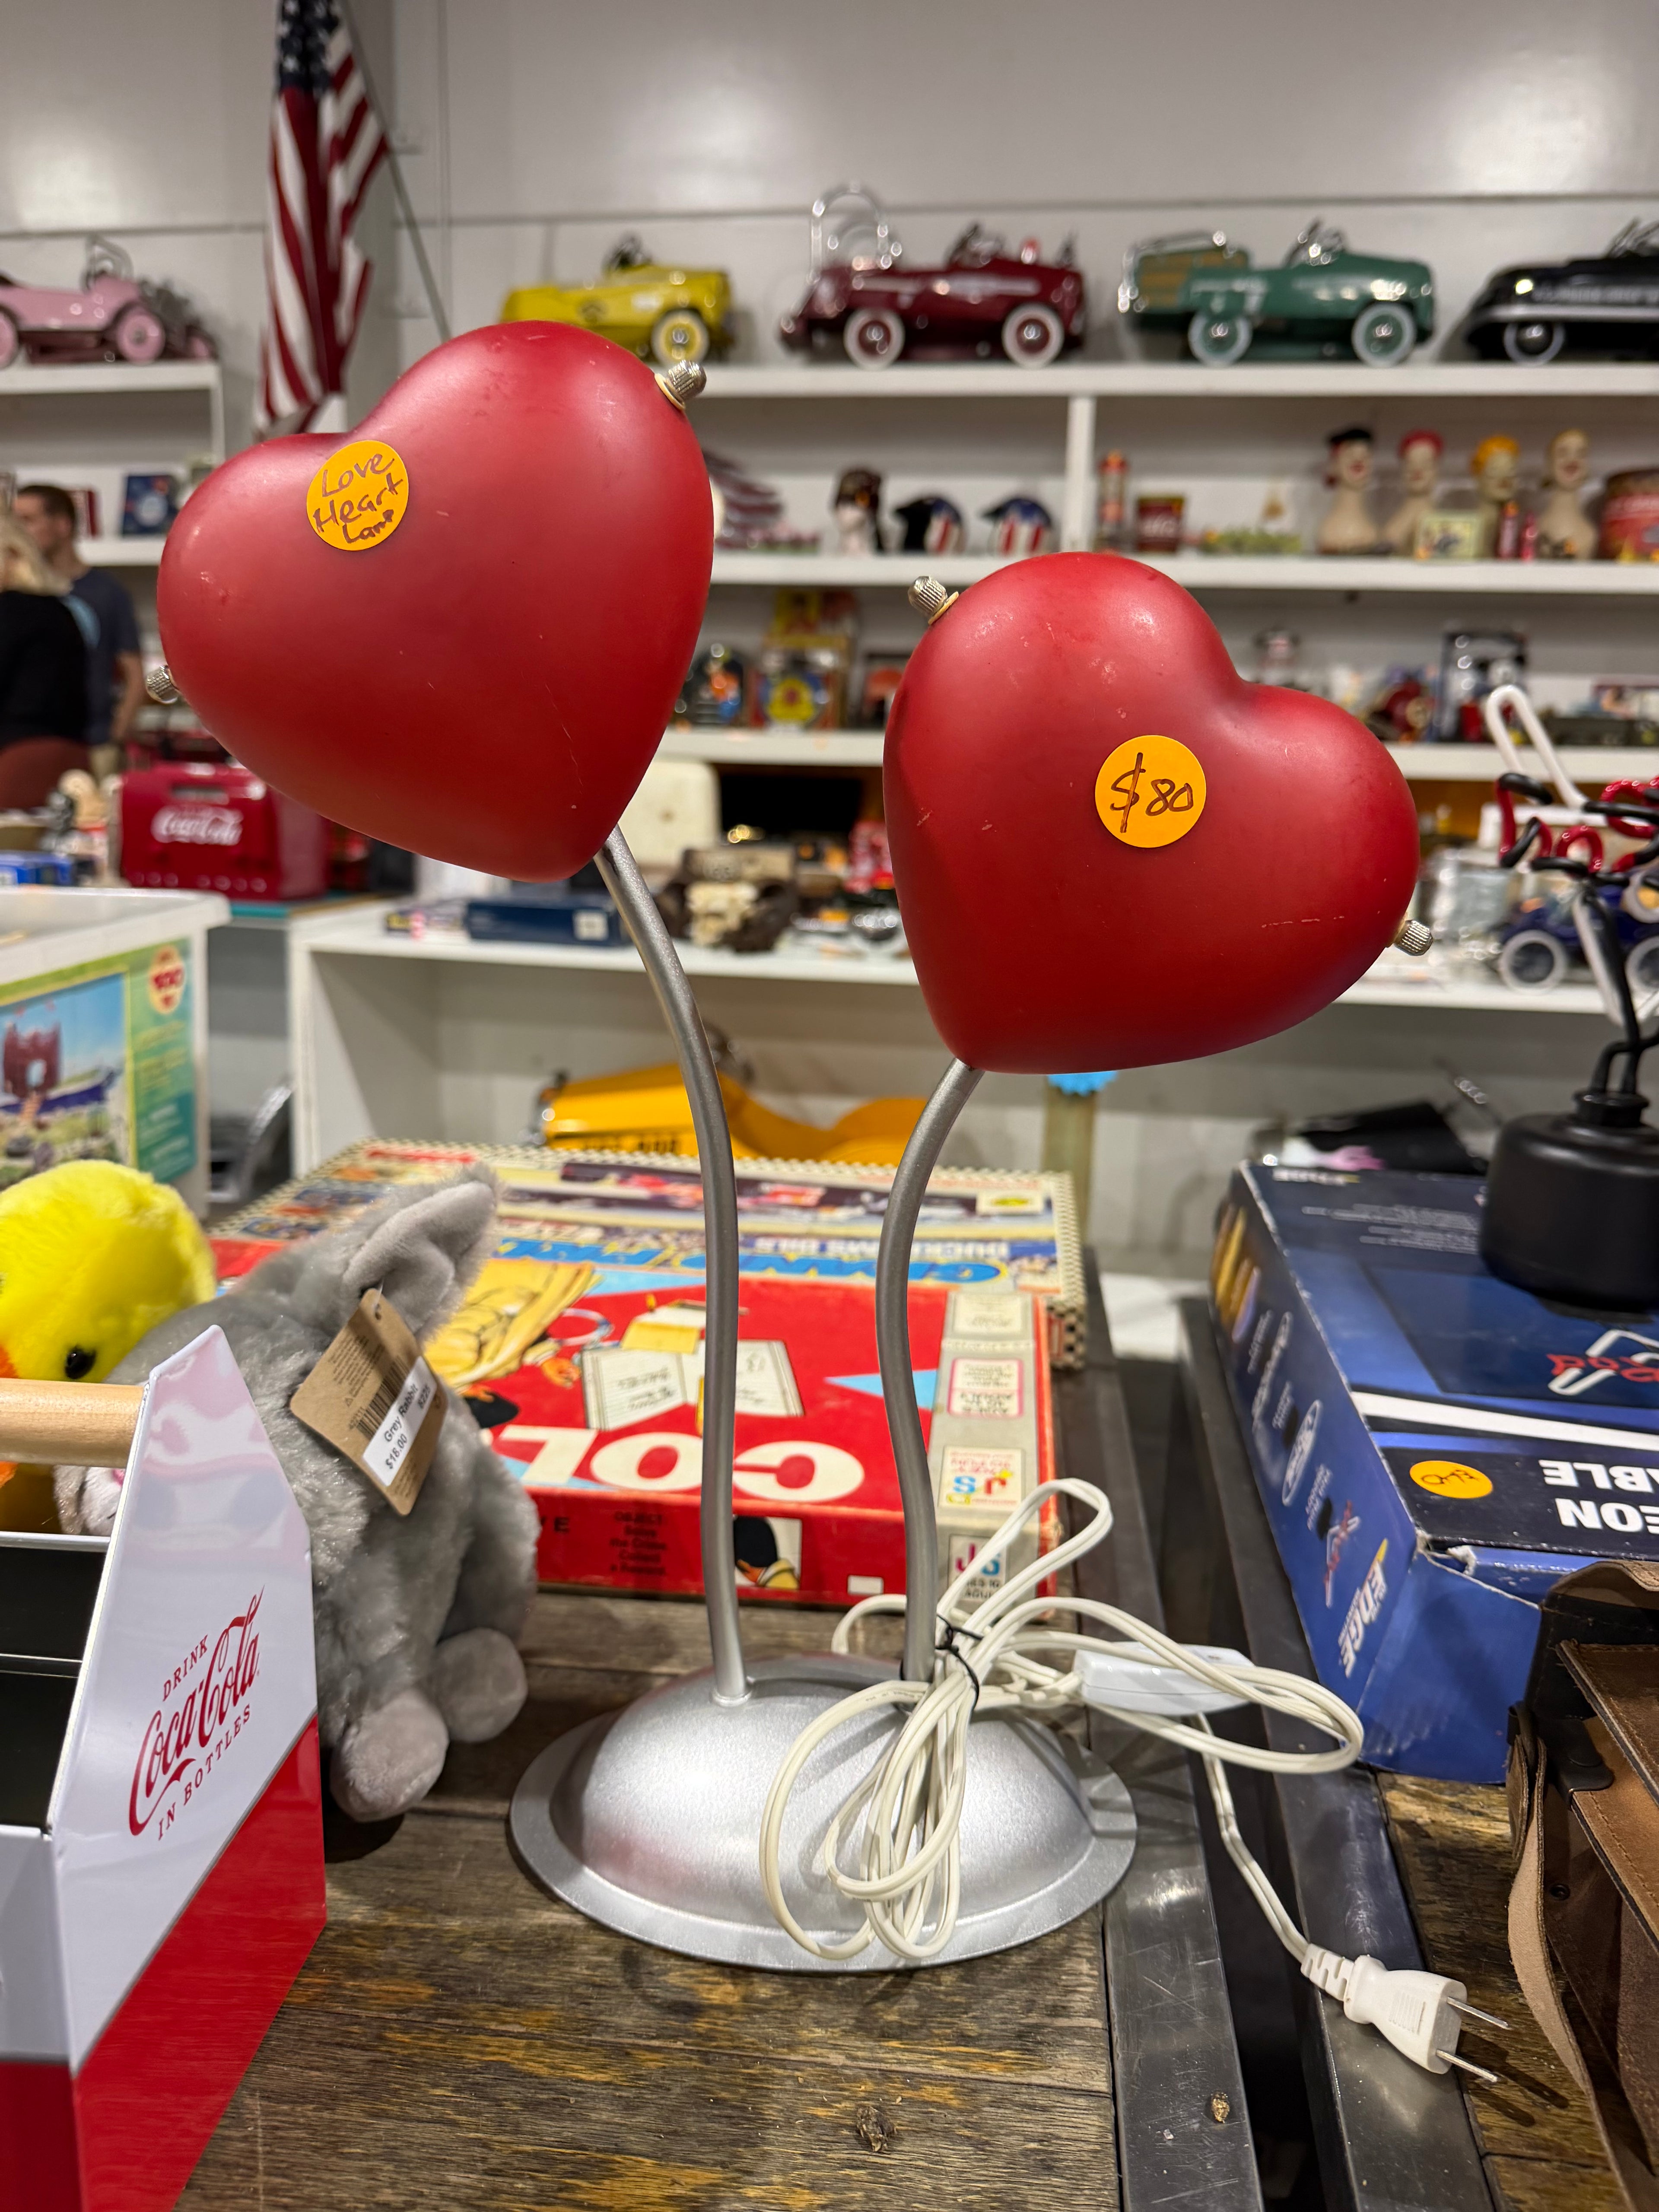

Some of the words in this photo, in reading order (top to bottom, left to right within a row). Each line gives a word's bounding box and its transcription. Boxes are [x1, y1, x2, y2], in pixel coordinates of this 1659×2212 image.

[313, 473, 403, 532] Heart
[322, 454, 394, 497] Love
[1110, 752, 1194, 833] $80
[384, 1417, 402, 1442] Grey
[398, 1384, 418, 1418] Rabbit
[386, 1433, 407, 1469] $18.00
[480, 1424, 864, 1503] COL
[162, 1634, 208, 1701] DRINK
[129, 1584, 265, 1836] Coca-Cola
[158, 1802, 175, 1841] IN
[183, 1703, 250, 1806] BOTTLES
